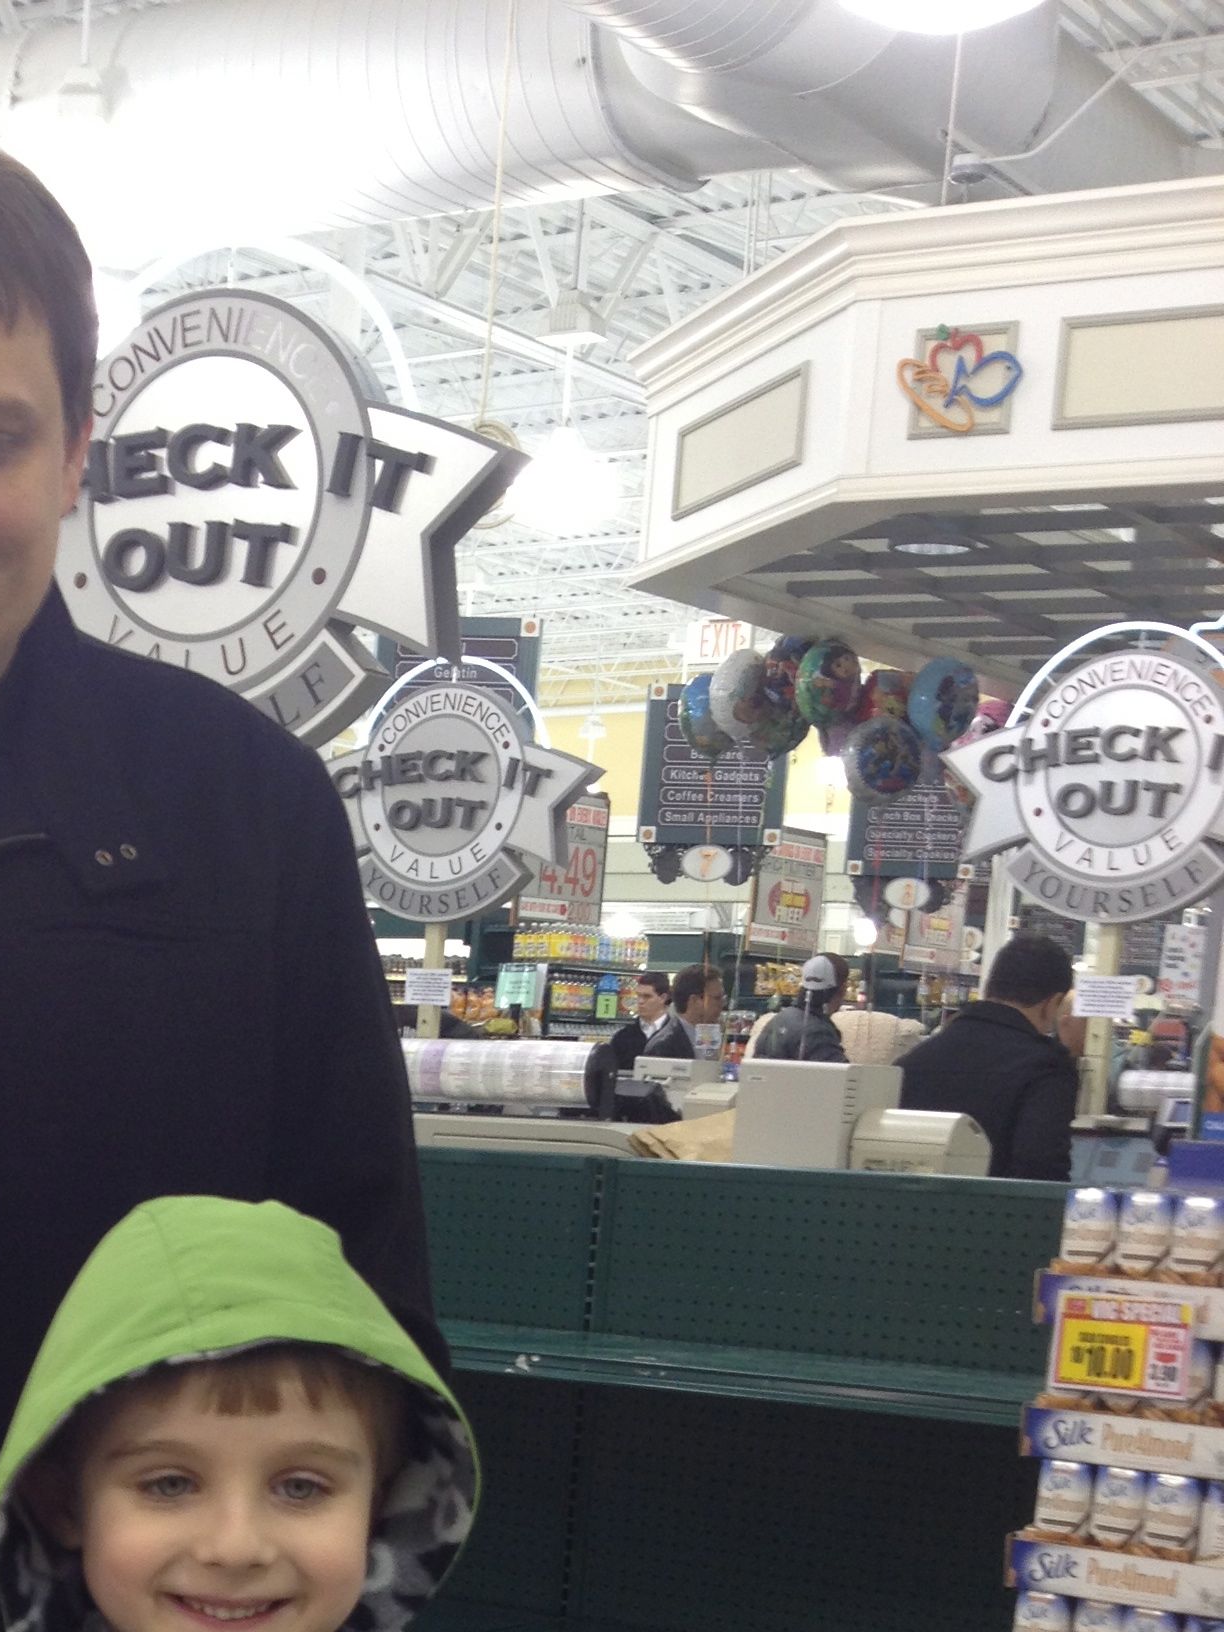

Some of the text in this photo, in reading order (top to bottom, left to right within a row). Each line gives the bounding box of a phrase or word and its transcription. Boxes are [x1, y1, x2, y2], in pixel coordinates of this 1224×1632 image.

[92, 306, 336, 418] CONVENIENC
[79, 423, 439, 514] HECK IT
[102, 518, 300, 593] OUT
[700, 624, 742, 657] EXIT
[1045, 660, 1213, 719] CONVENIENCE
[382, 692, 510, 745] CONVENIENCE
[980, 724, 1187, 782] CHECK
[333, 749, 553, 799] CHECK IT
[670, 769, 712, 782] Kitche
[388, 797, 489, 831] OUT
[667, 790, 759, 803] Coffee Creamers
[871, 810, 902, 820] Lnch
[903, 811, 921, 821] Box
[1057, 780, 1182, 819] OUT
[665, 812, 759, 825] Small Appliances
[869, 828, 913, 841] Specialty
[390, 843, 487, 880] VALUE
[1055, 827, 1186, 871] VALUE
[365, 867, 503, 915] YOURSELF
[1023, 857, 1203, 914] YOURSELF
[1044, 1419, 1093, 1449] Silk
[1030, 1553, 1078, 1582] Silk
